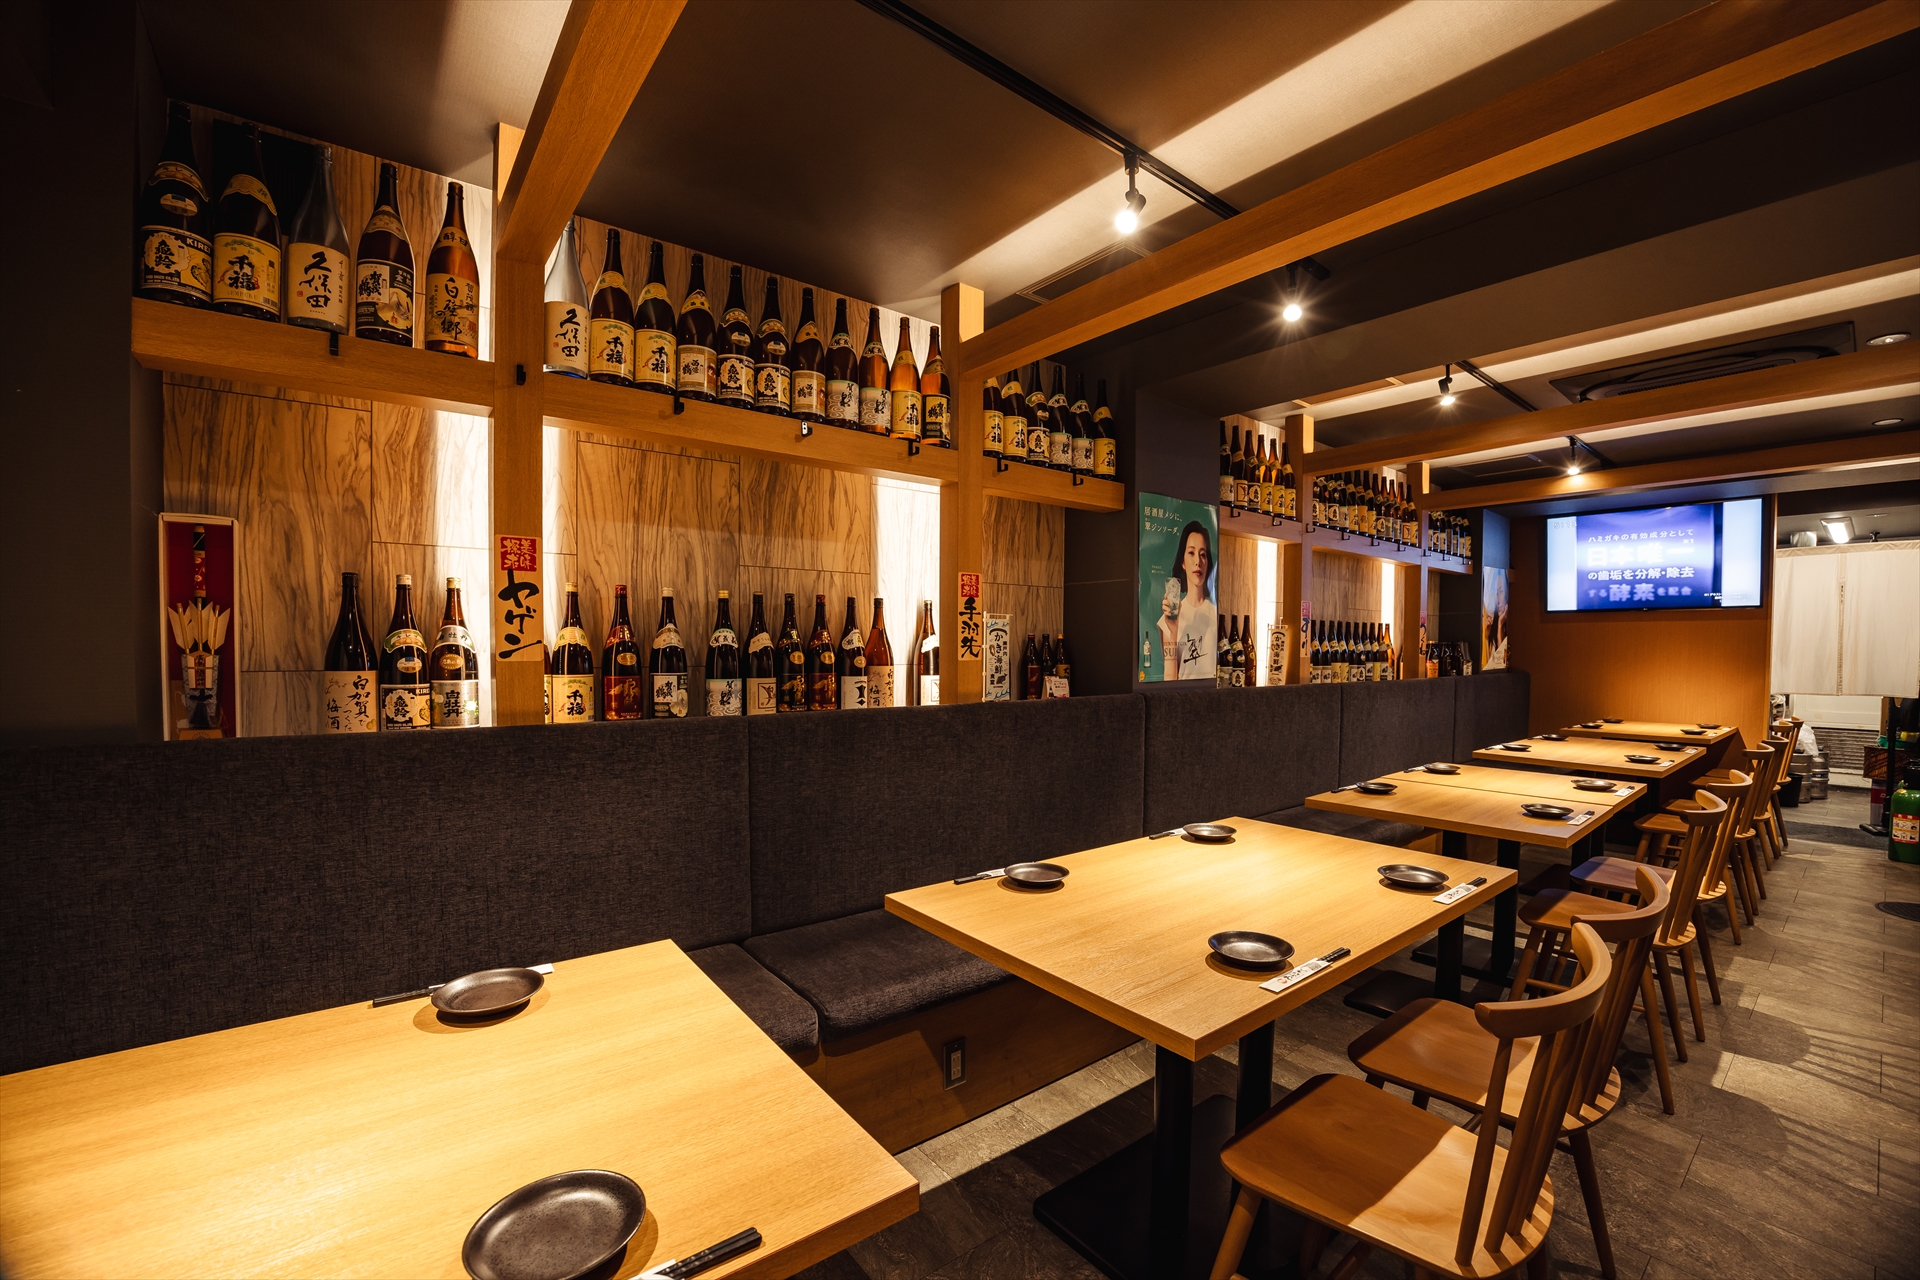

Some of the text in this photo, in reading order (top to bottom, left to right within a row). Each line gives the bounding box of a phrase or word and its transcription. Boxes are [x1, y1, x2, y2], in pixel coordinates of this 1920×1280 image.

[228, 254, 257, 291] 千福
[299, 250, 332, 309] 久保田
[435, 276, 463, 341] 白壁の郷
[555, 308, 581, 357] 久保田
[605, 336, 624, 365] 千福
[651, 346, 670, 373] 千福
[906, 403, 919, 426] 千福
[1588, 529, 1694, 543] ハミガキの有効成分として
[1588, 566, 1694, 581] の歯垢を分解・除去
[498, 568, 542, 659] ヤゲン
[959, 596, 981, 658] 手羽先
[994, 632, 1004, 676] かき海鮮
[326, 698, 342, 731] 梅酒
[443, 690, 464, 718] 白牡丹
[566, 690, 584, 716] 千福
